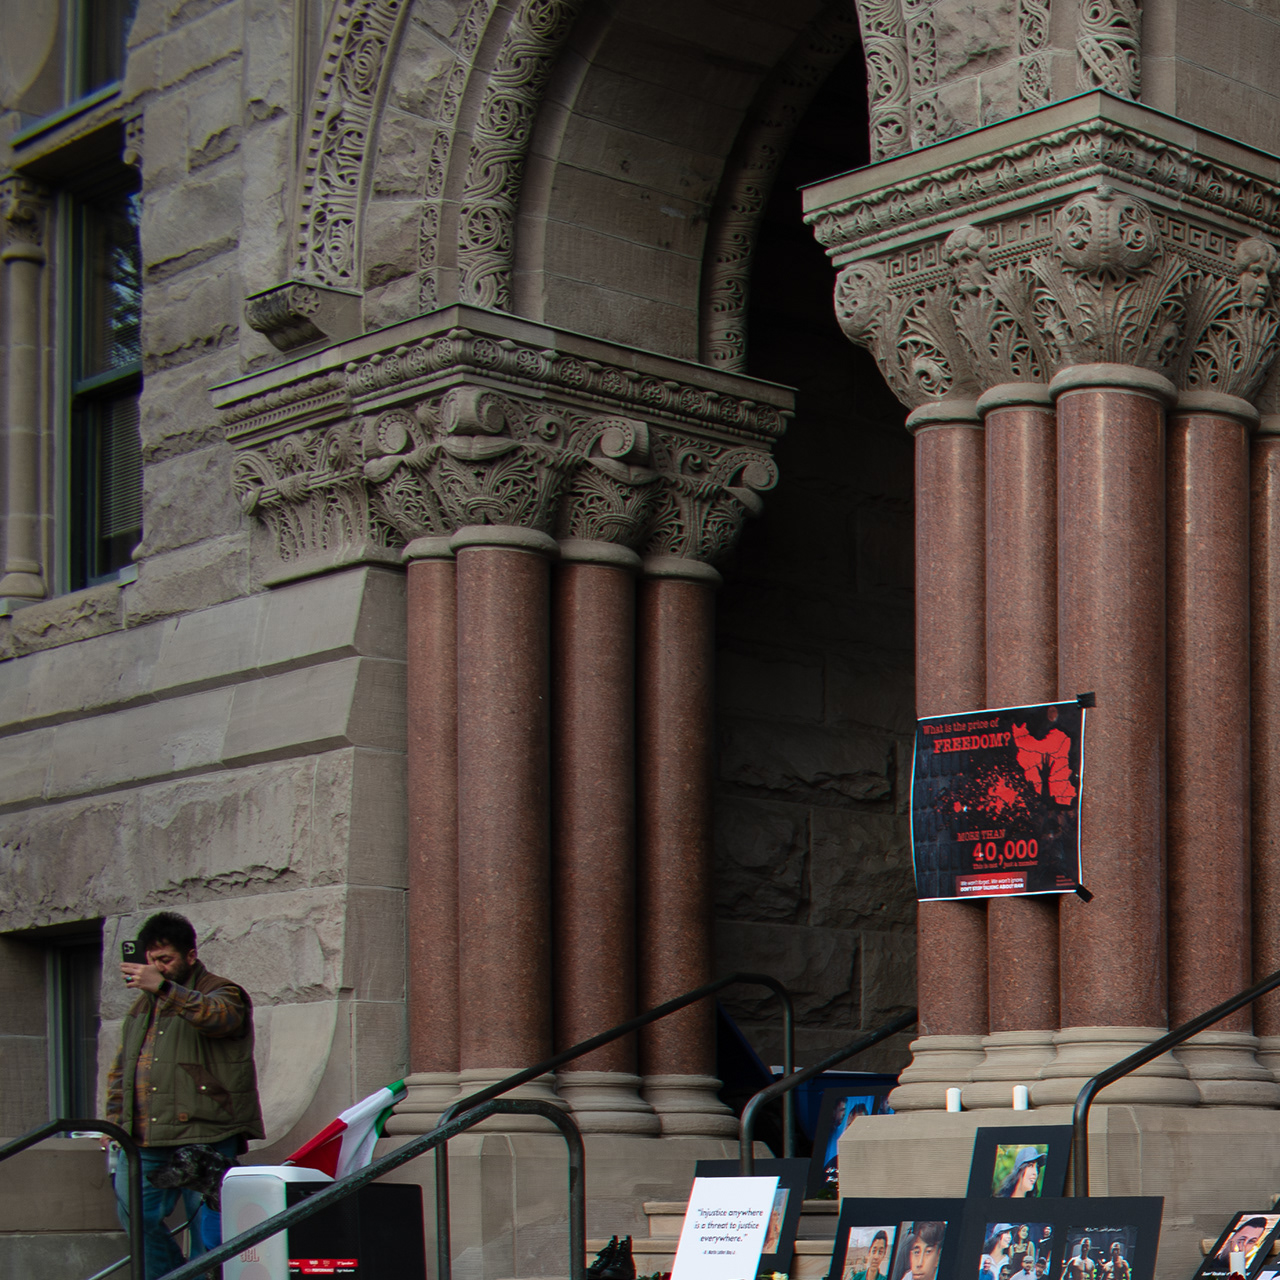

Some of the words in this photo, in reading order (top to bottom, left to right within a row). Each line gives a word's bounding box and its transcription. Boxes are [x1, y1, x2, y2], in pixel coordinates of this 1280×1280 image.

[923, 724, 943, 735] What
[945, 723, 951, 732] is
[953, 720, 966, 731] the
[968, 719, 988, 733] price
[933, 732, 1011, 754] FREEDOM?
[981, 829, 1006, 839] THAN
[972, 839, 1038, 866] 40,000
[728, 1208, 764, 1218] anywhere
[707, 1220, 728, 1229] threat
[736, 1220, 760, 1231] justice
